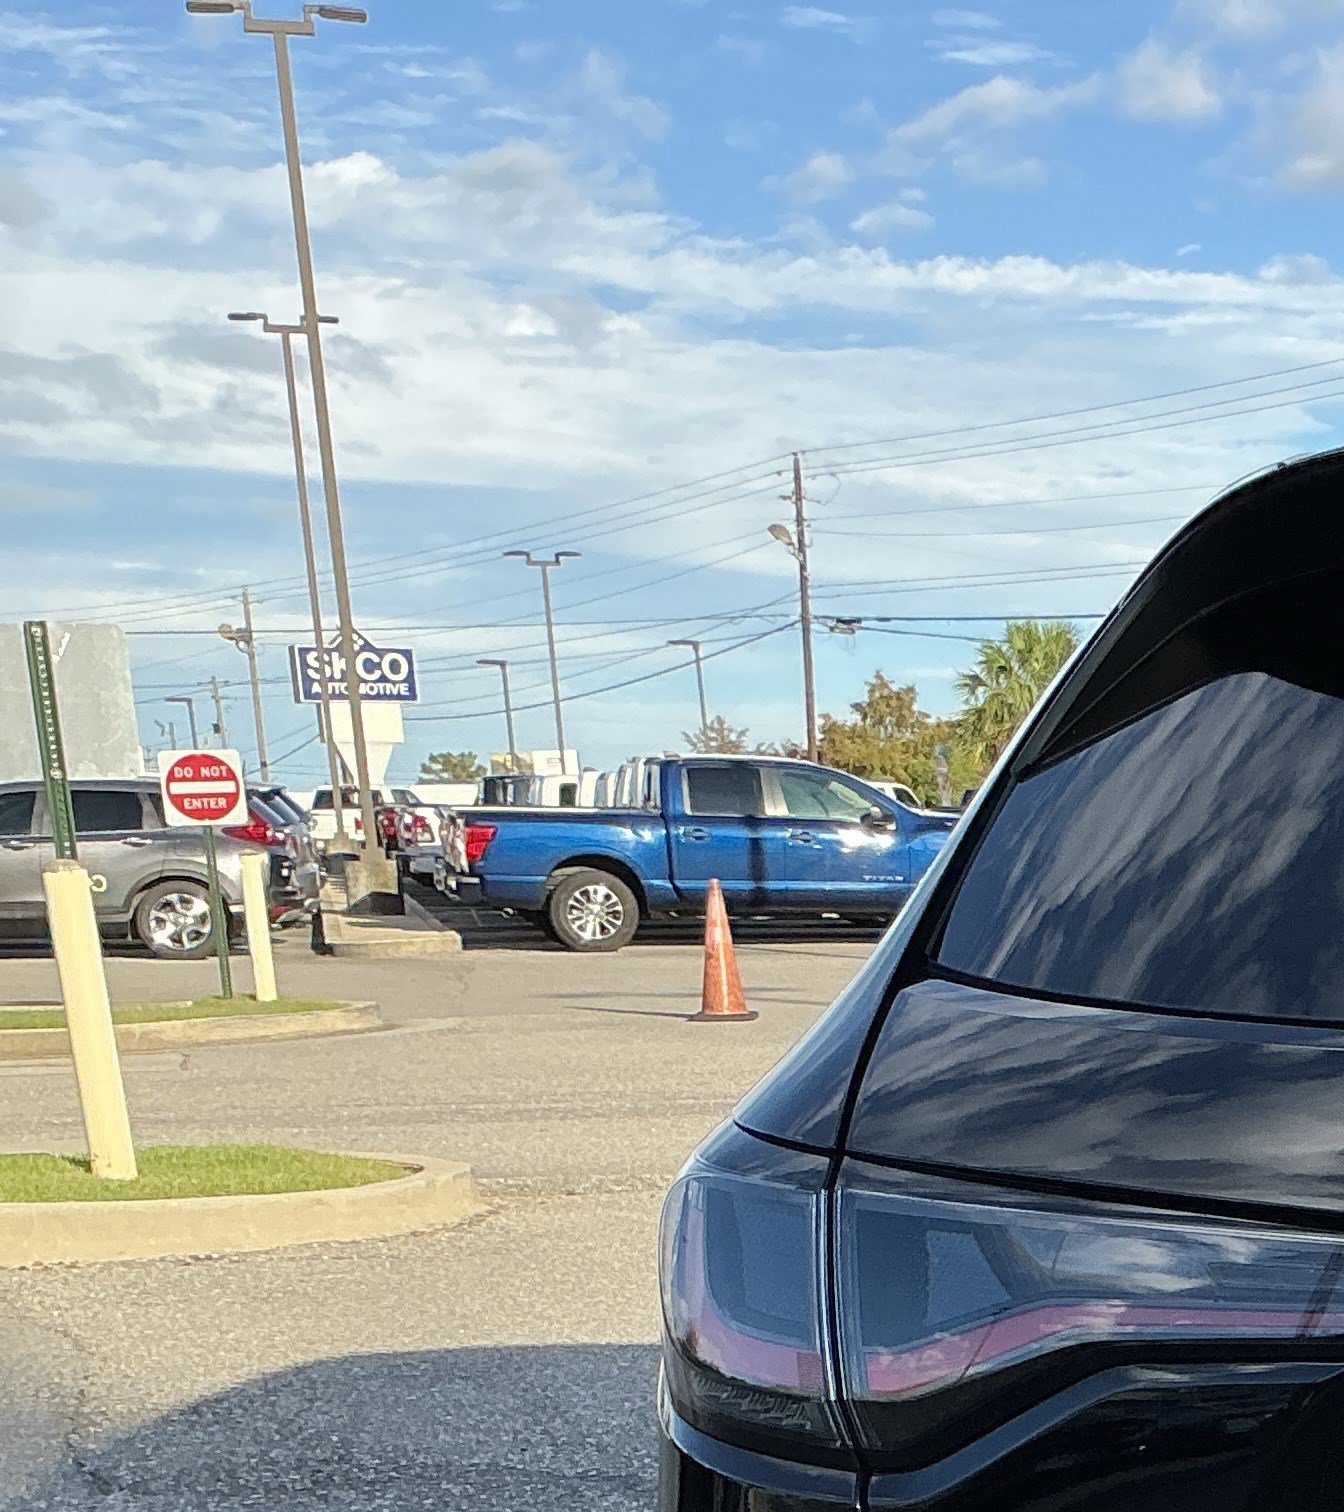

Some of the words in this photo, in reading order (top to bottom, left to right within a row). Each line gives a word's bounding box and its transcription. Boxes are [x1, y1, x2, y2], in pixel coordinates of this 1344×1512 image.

[305, 651, 409, 681] SKCO
[173, 766, 194, 778] DO
[200, 765, 229, 778] NOT
[183, 797, 228, 810] ENTER
